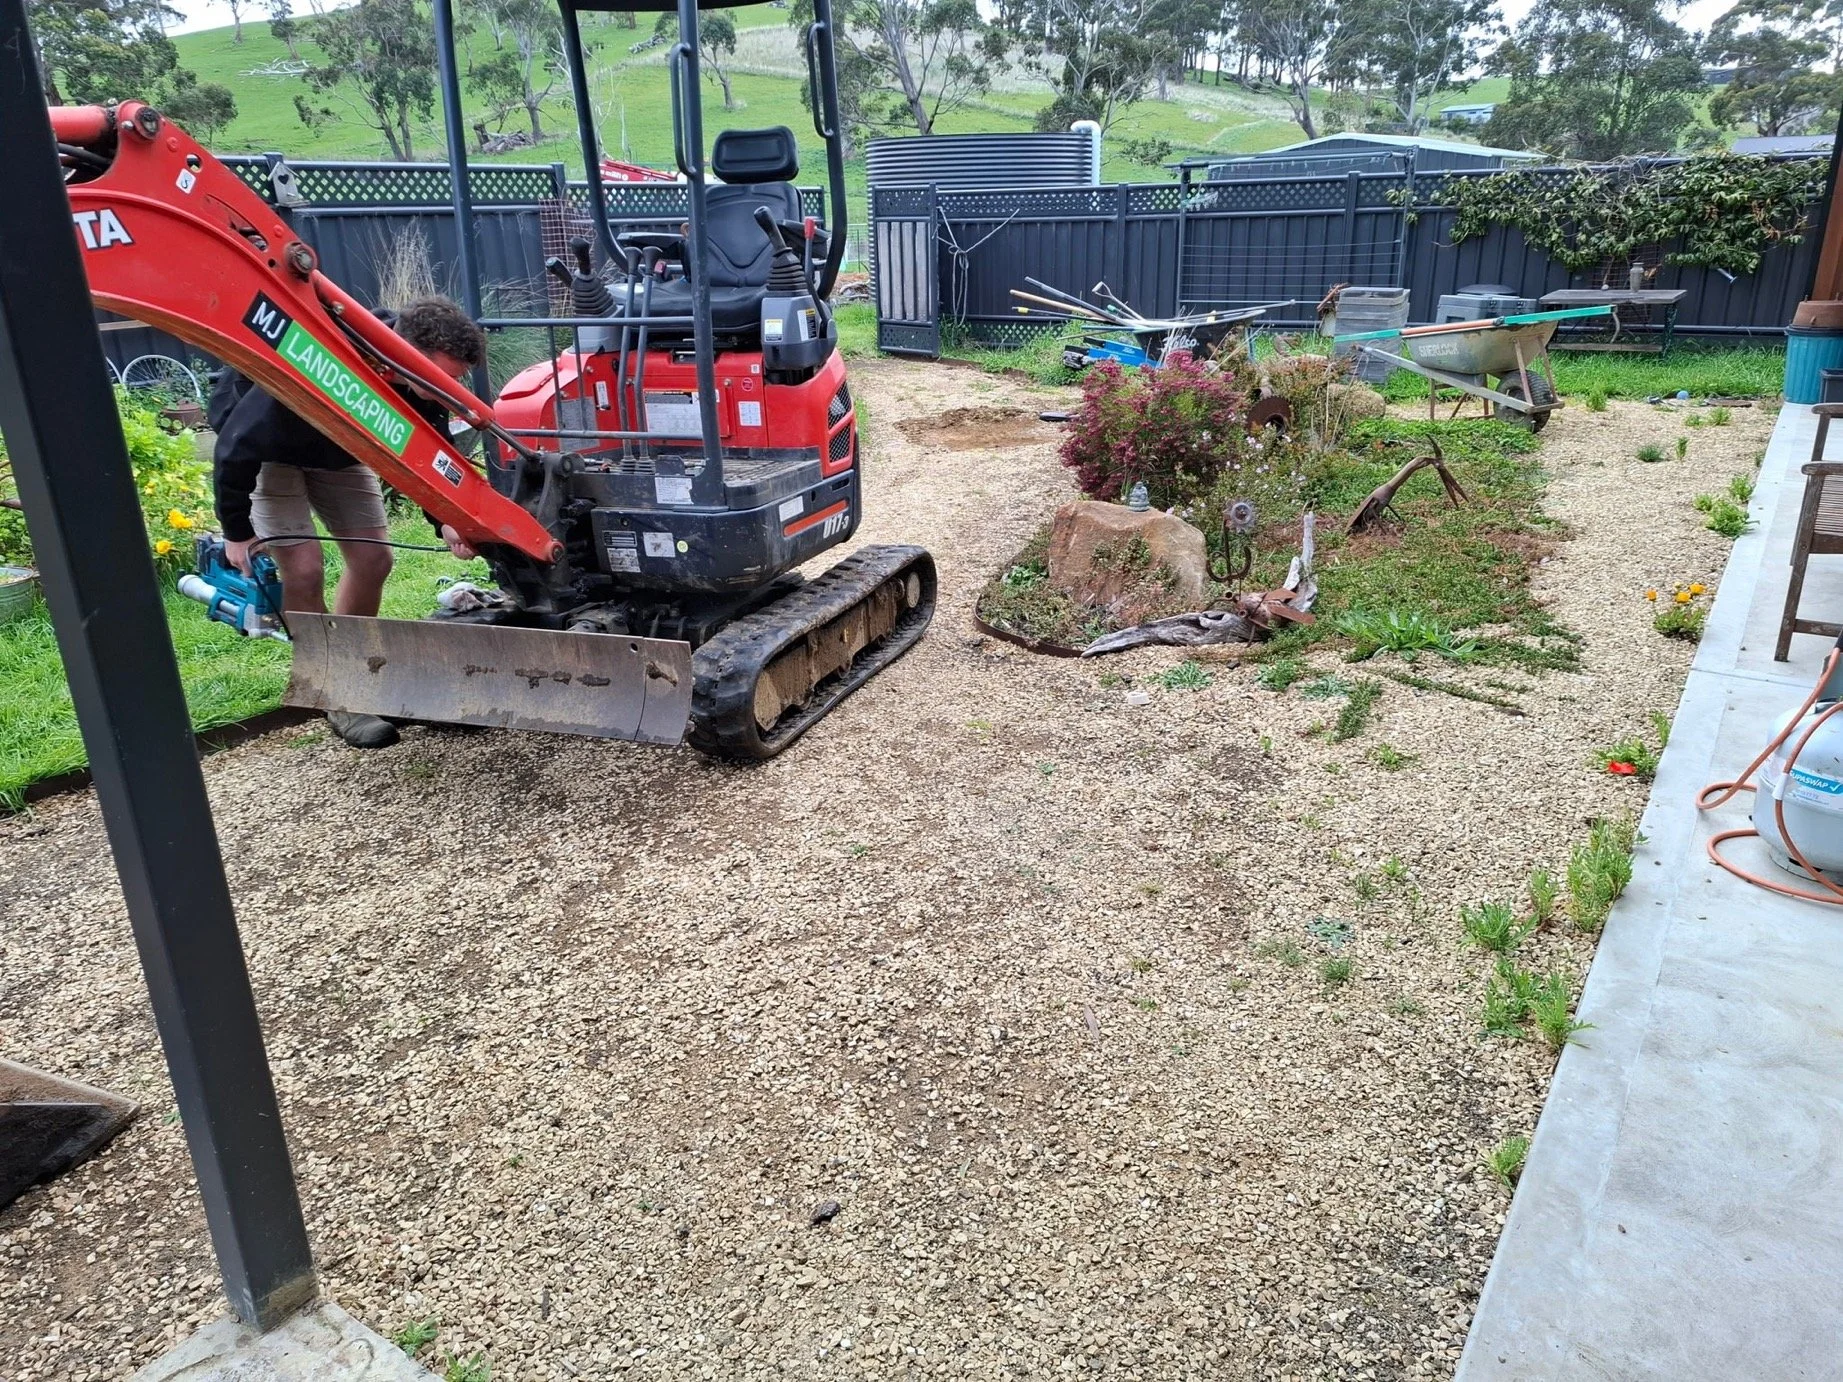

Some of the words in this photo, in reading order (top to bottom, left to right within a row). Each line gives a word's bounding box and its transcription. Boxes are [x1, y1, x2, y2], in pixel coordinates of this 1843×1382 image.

[251, 300, 287, 340] MJ
[286, 331, 406, 446] LANDSCAPING
[823, 512, 850, 539] U17-3
